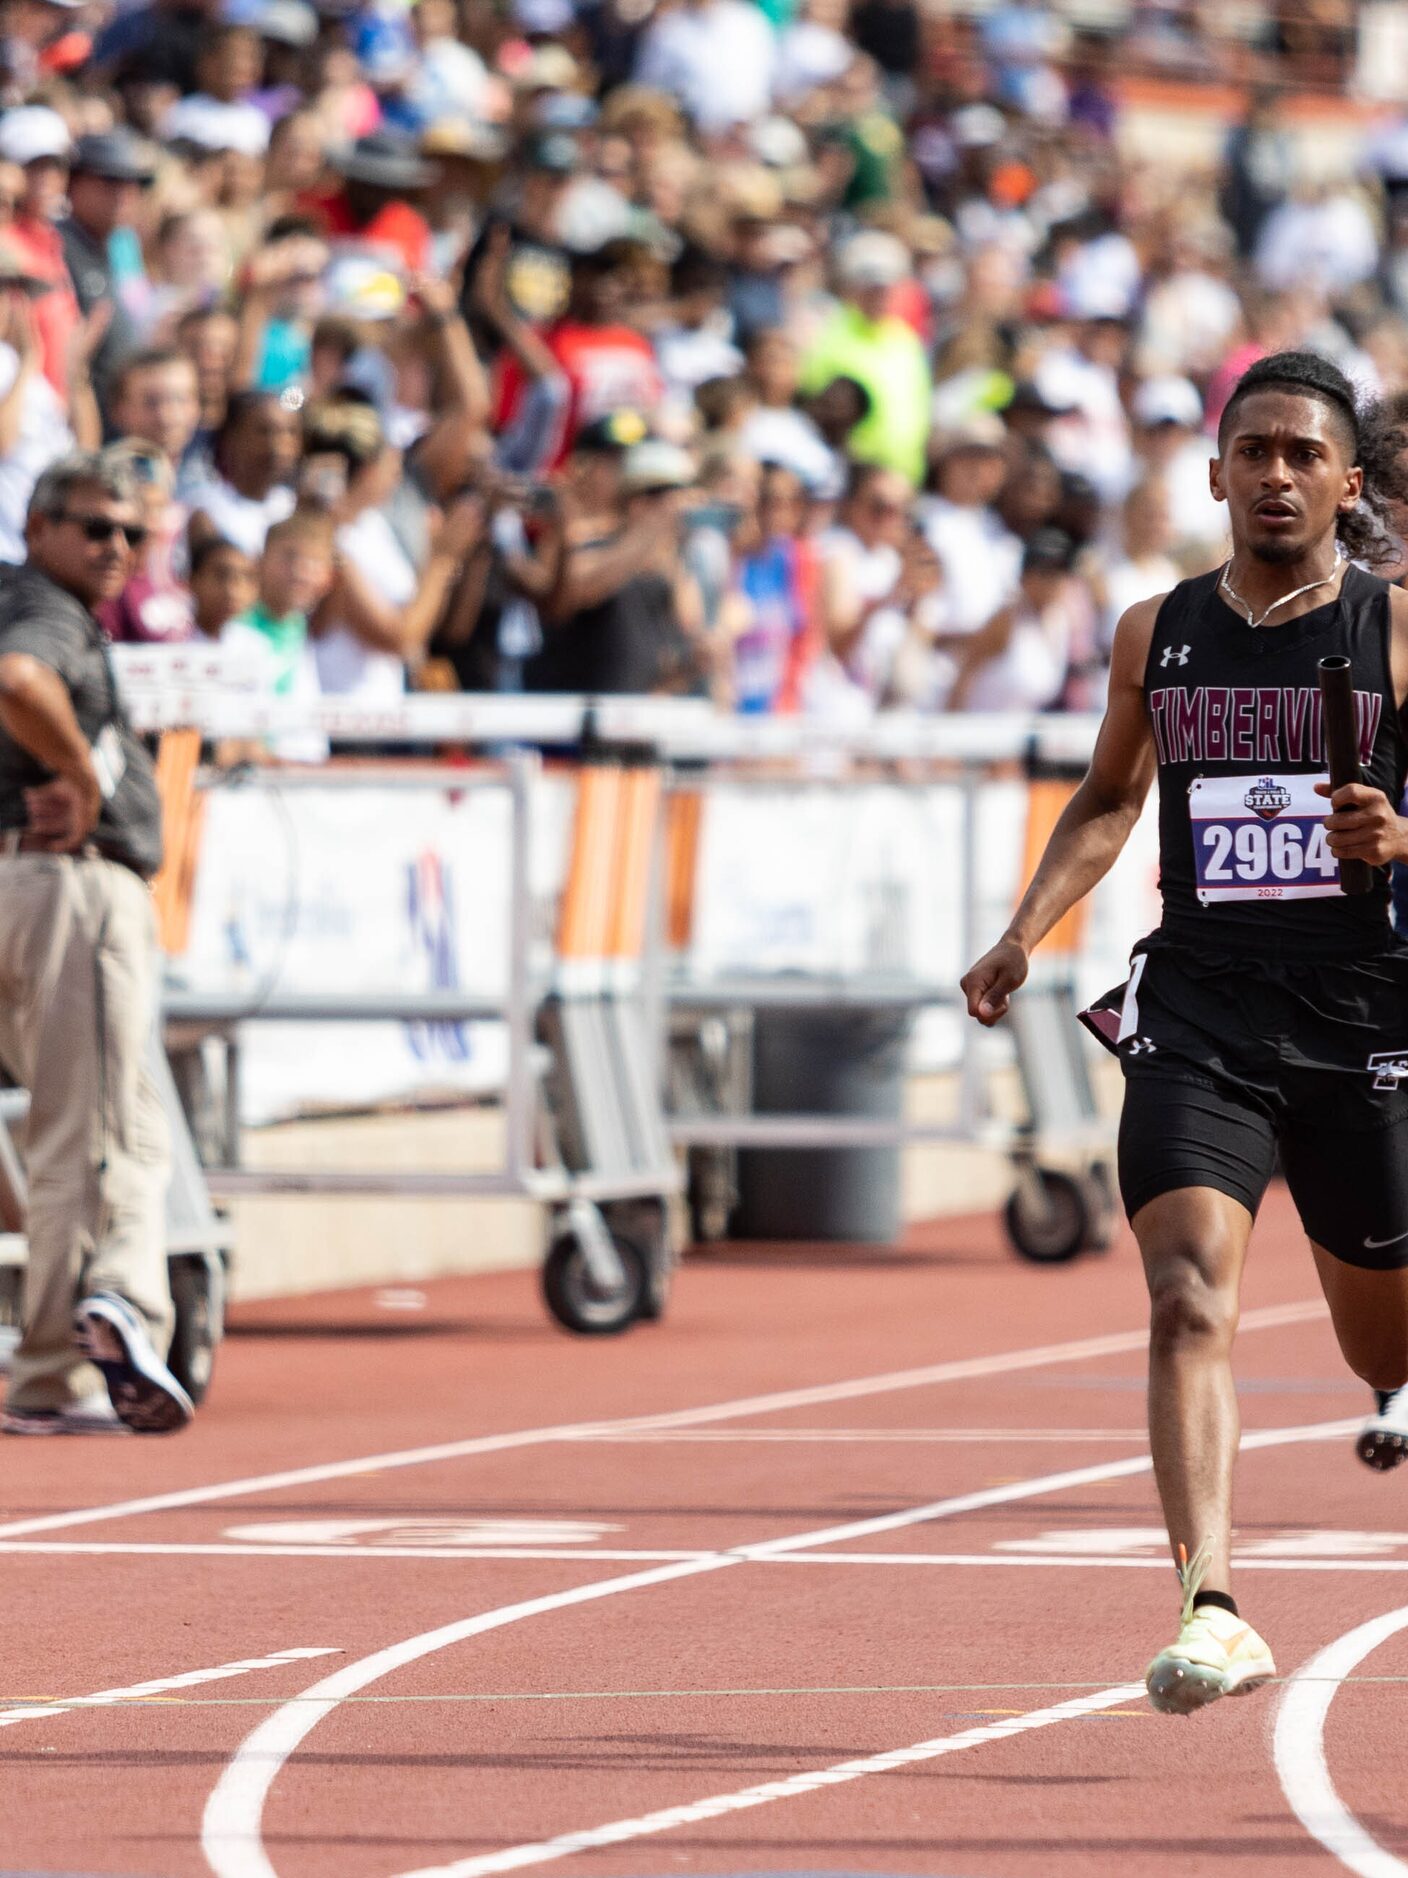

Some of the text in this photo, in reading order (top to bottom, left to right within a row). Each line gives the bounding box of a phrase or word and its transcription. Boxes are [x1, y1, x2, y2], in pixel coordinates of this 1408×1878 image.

[1150, 686, 1383, 768] TIMBERVIW
[1245, 793, 1291, 806] STATE
[1203, 823, 1339, 881] 2964
[1257, 888, 1284, 897] 2022
